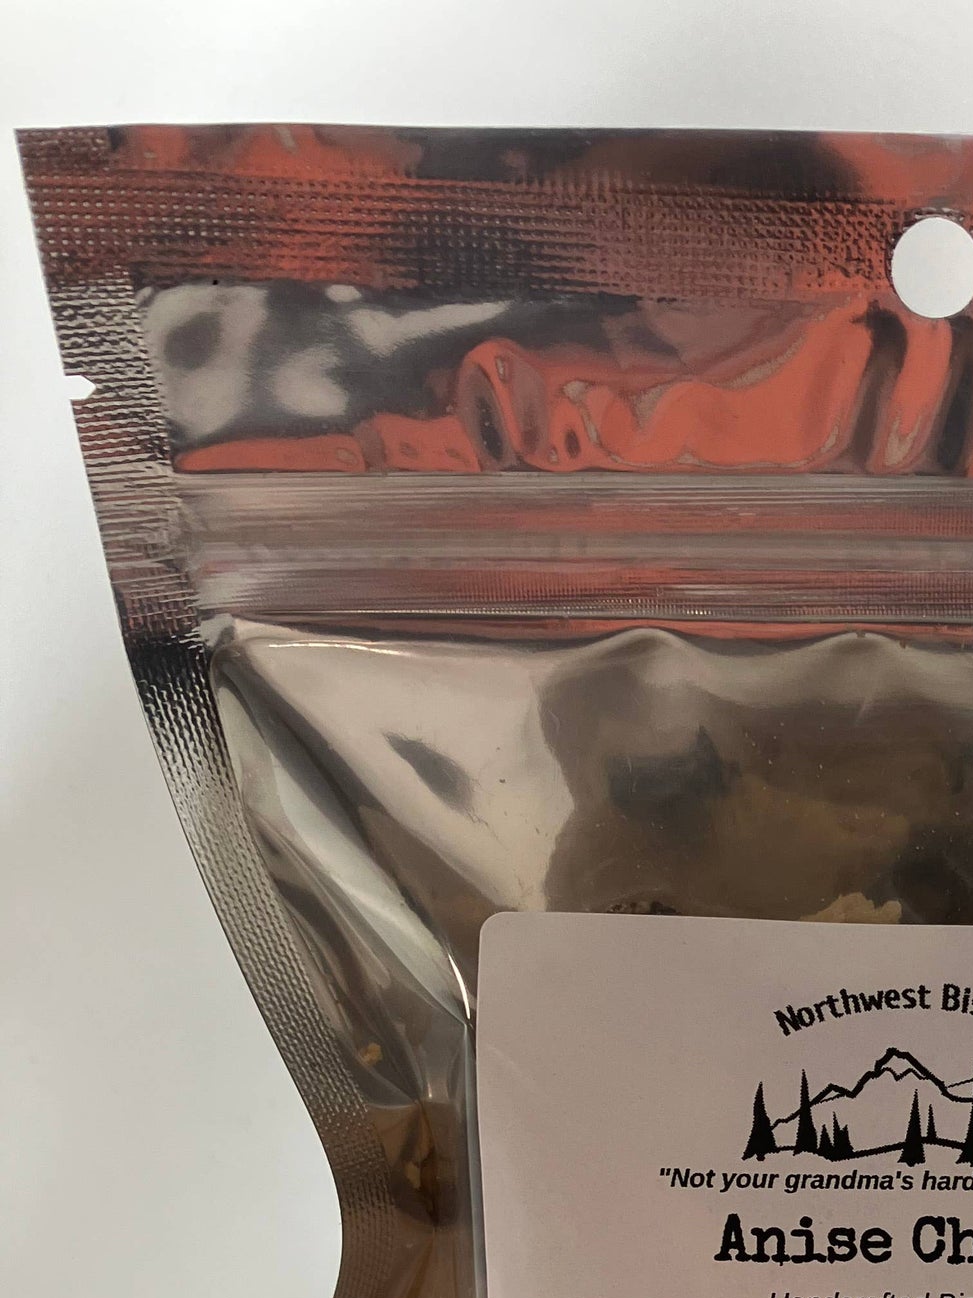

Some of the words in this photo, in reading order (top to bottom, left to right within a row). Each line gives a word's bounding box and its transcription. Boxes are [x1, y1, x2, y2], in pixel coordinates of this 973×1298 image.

[774, 984, 931, 1036] Northwest
[659, 1167, 717, 1189] "Not
[719, 1172, 780, 1194] your
[783, 1168, 915, 1195] grandma's
[713, 1212, 894, 1267] Anise
